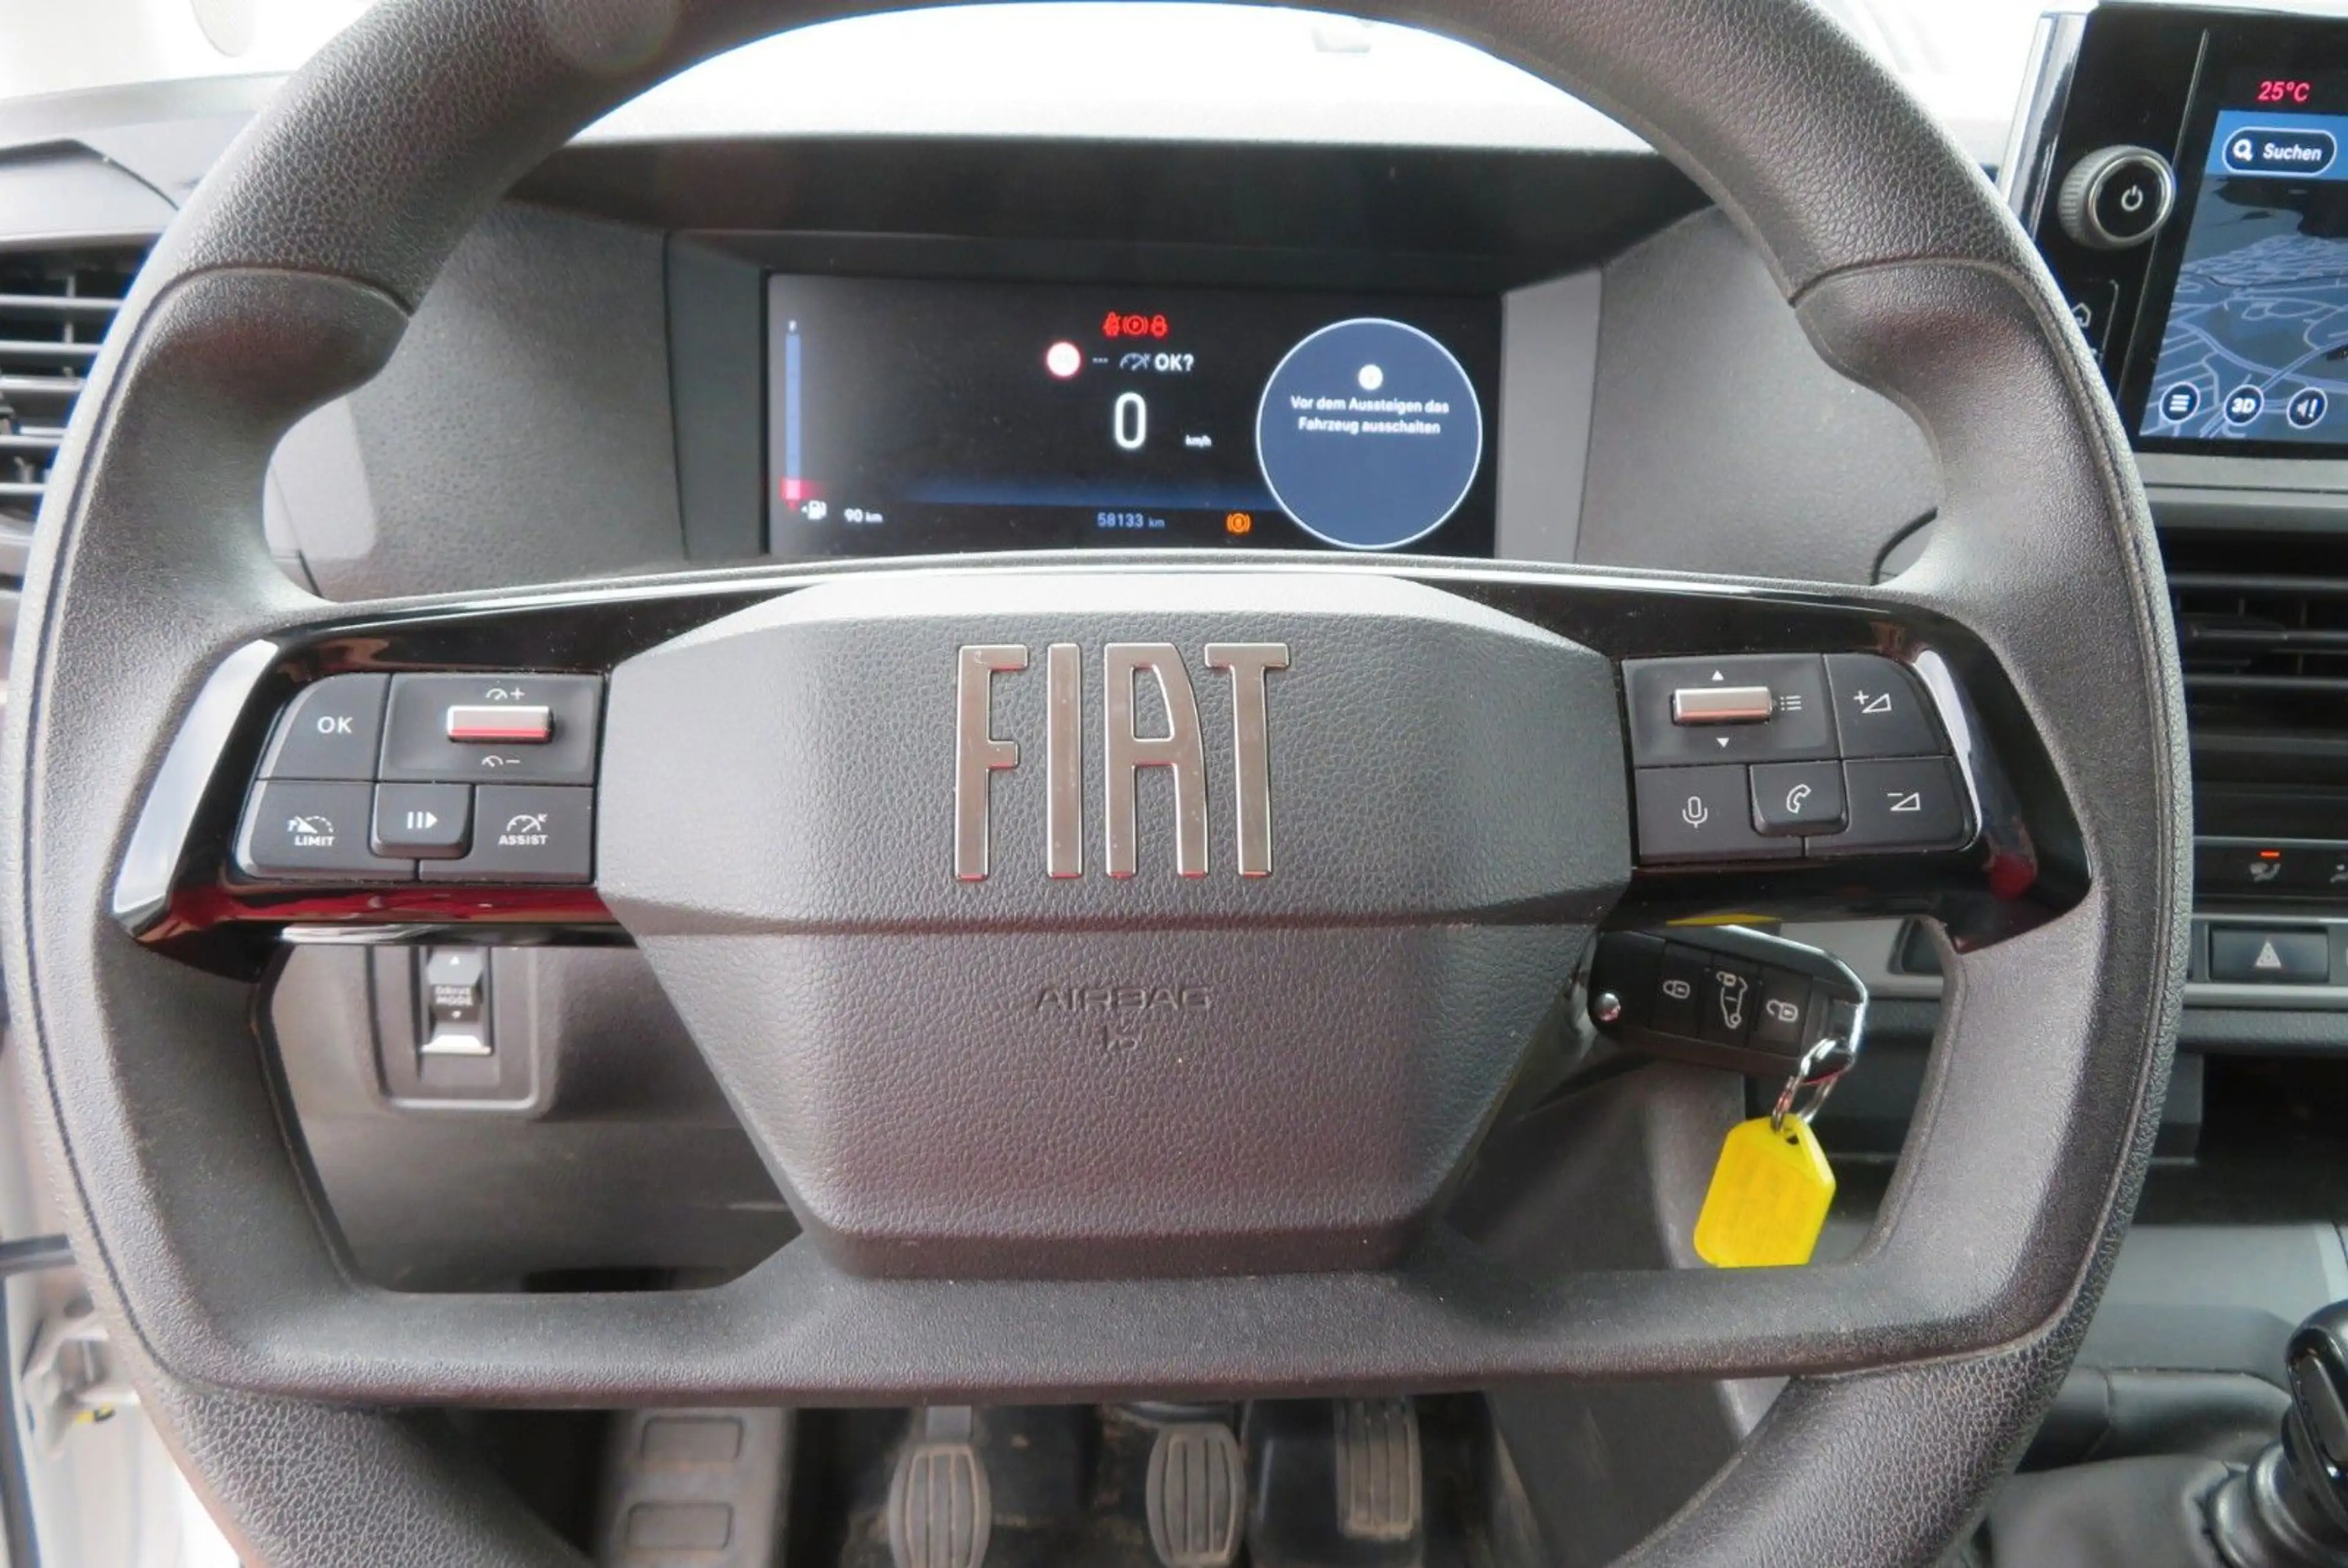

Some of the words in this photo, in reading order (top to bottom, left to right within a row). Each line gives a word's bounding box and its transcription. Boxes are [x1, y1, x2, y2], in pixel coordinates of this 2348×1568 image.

[2258, 80, 2310, 103] 25°C
[2262, 142, 2323, 161] Suchen
[1154, 352, 1194, 372] OK?
[1290, 396, 1314, 410] Vor
[1316, 396, 1346, 410] dem
[1348, 397, 1423, 416] Aussteigen
[1424, 399, 1450, 414] das
[2231, 397, 2257, 414] 3D
[1115, 391, 1146, 450] 0
[1298, 416, 1359, 435] Fahrzeug
[1361, 419, 1441, 435] ausschalten
[1096, 512, 1144, 529] 58133
[1148, 517, 1165, 528] km
[317, 716, 352, 734] OK
[954, 642, 1290, 880] FIAT
[294, 835, 336, 847] LIMIT
[498, 834, 549, 846] ASSIST
[1035, 985, 1213, 1012] AIRBAG
